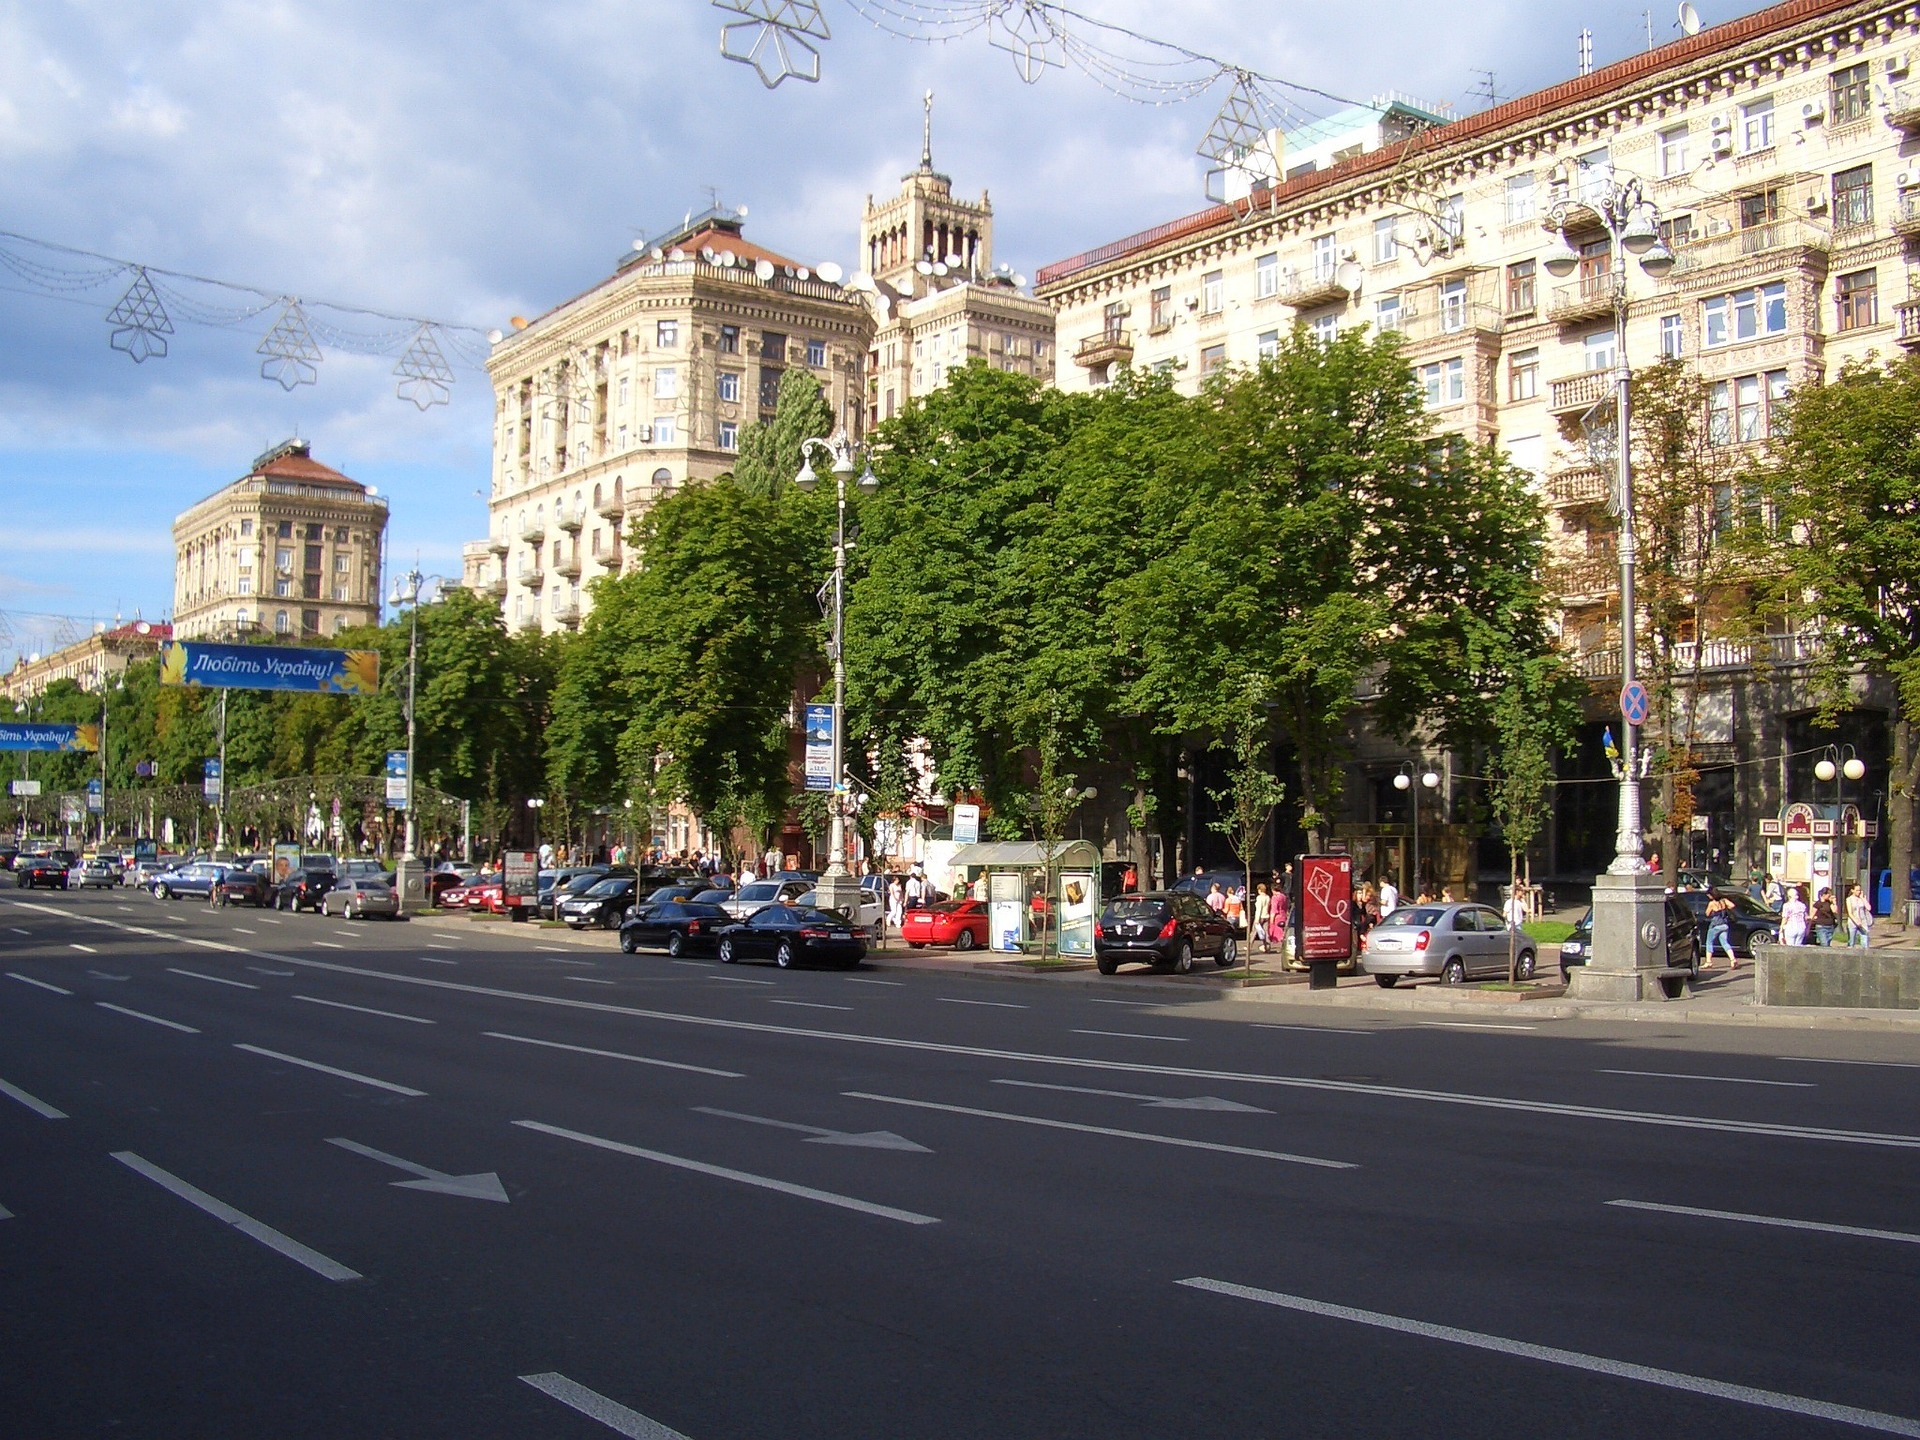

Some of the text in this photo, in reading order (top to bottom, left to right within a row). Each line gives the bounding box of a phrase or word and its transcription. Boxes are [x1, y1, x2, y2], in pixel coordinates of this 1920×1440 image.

[193, 654, 334, 680] Любіть Україну!
[23, 729, 70, 744] Україну!
